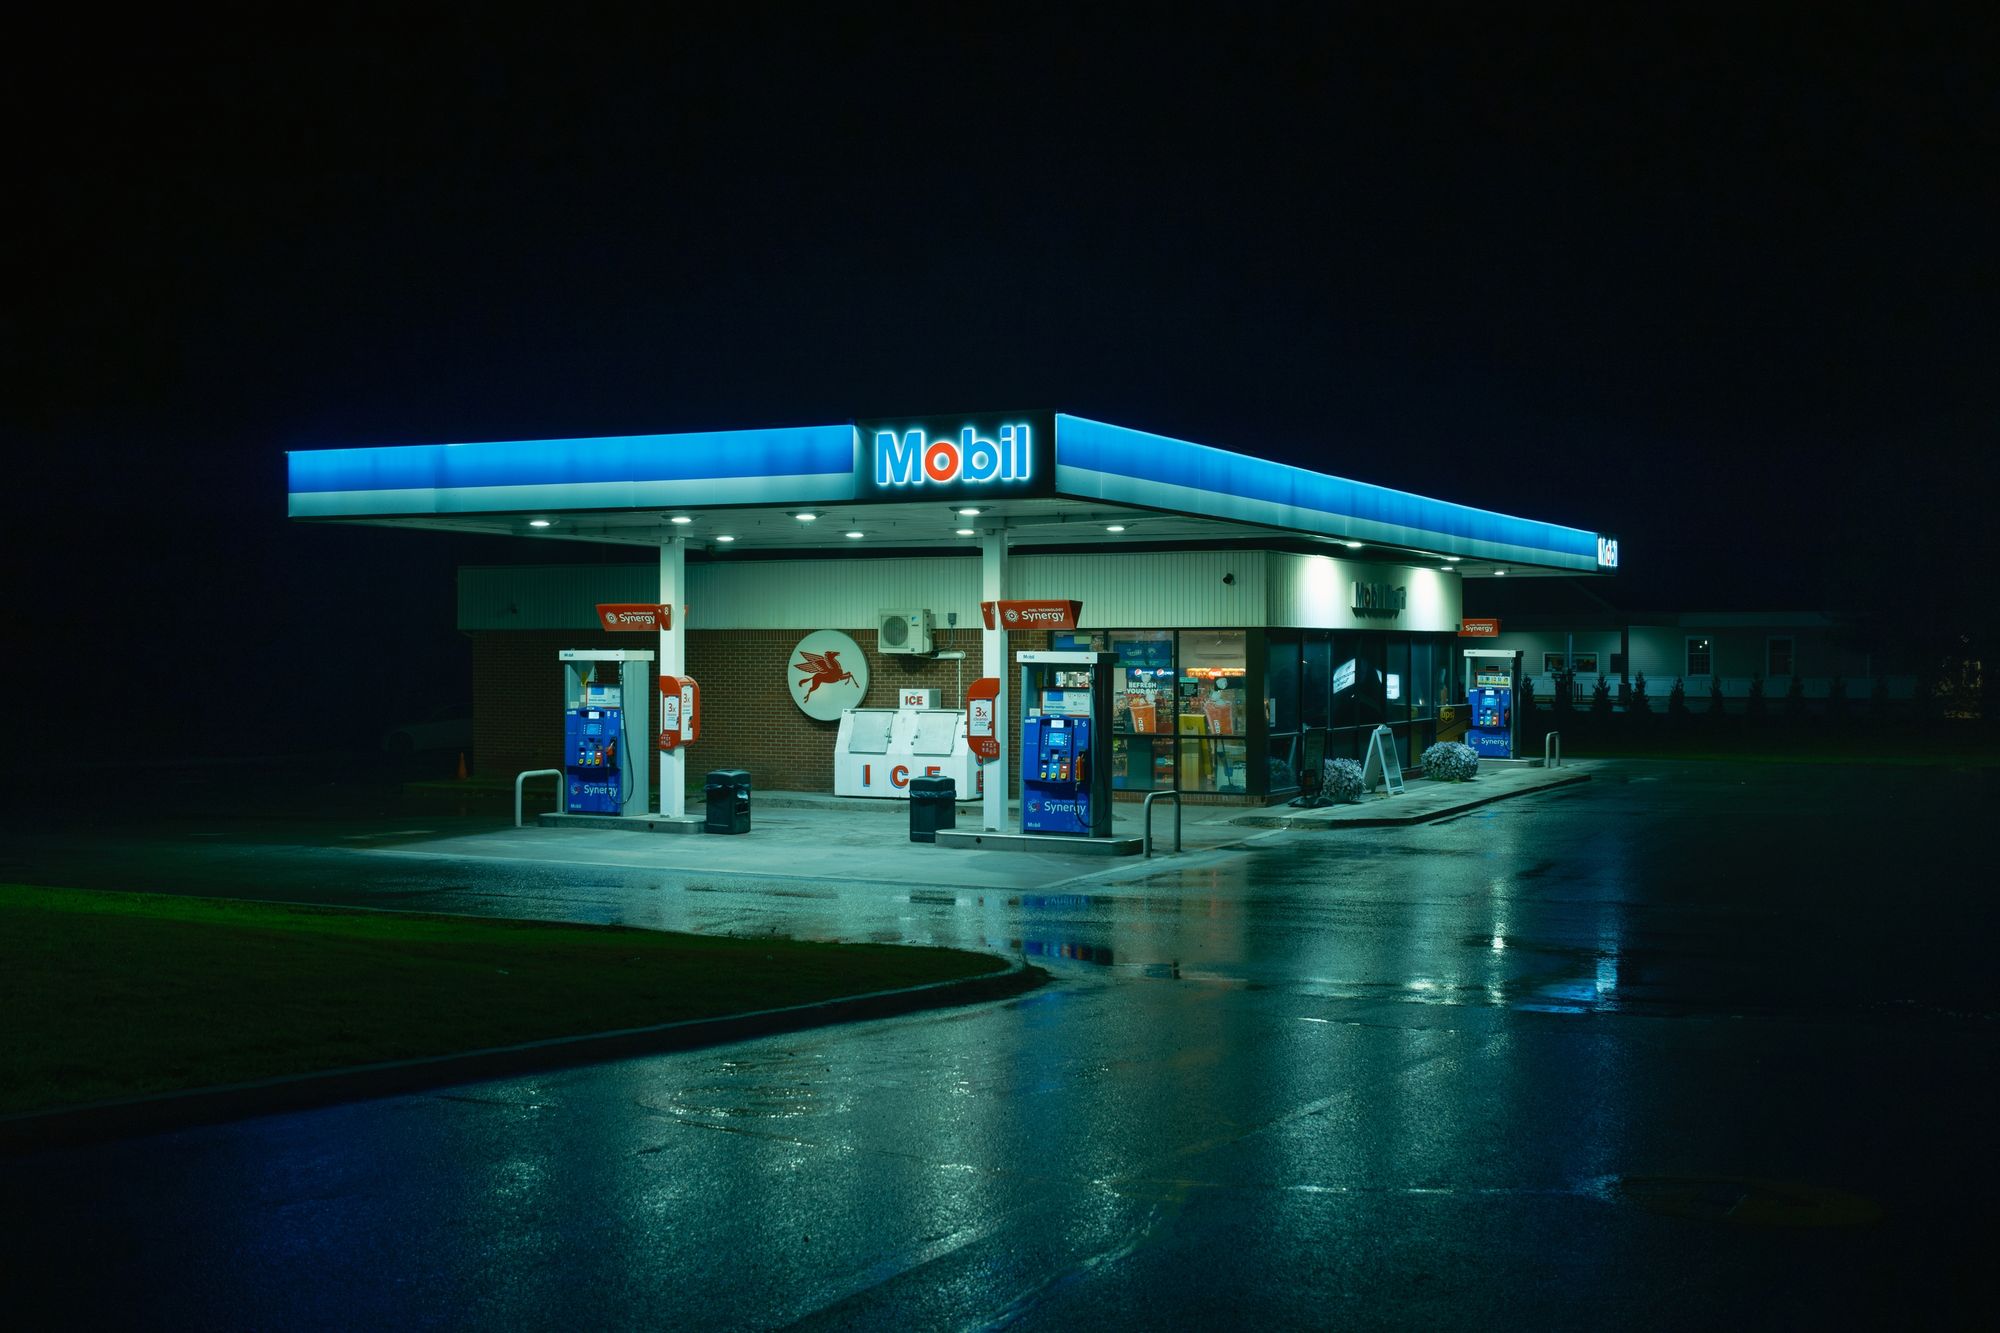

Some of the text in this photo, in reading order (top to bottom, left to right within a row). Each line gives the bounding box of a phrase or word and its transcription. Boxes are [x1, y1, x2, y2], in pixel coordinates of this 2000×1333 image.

[876, 424, 1030, 485] Mobil
[618, 613, 656, 624] Synergy
[1021, 610, 1065, 622] Synergy
[1465, 625, 1494, 633] Synergy
[905, 695, 923, 705] ICE
[975, 706, 988, 717] 3x
[1481, 737, 1509, 746] Synergy
[583, 784, 618, 797] Synergy
[1043, 801, 1087, 815] Synergy
